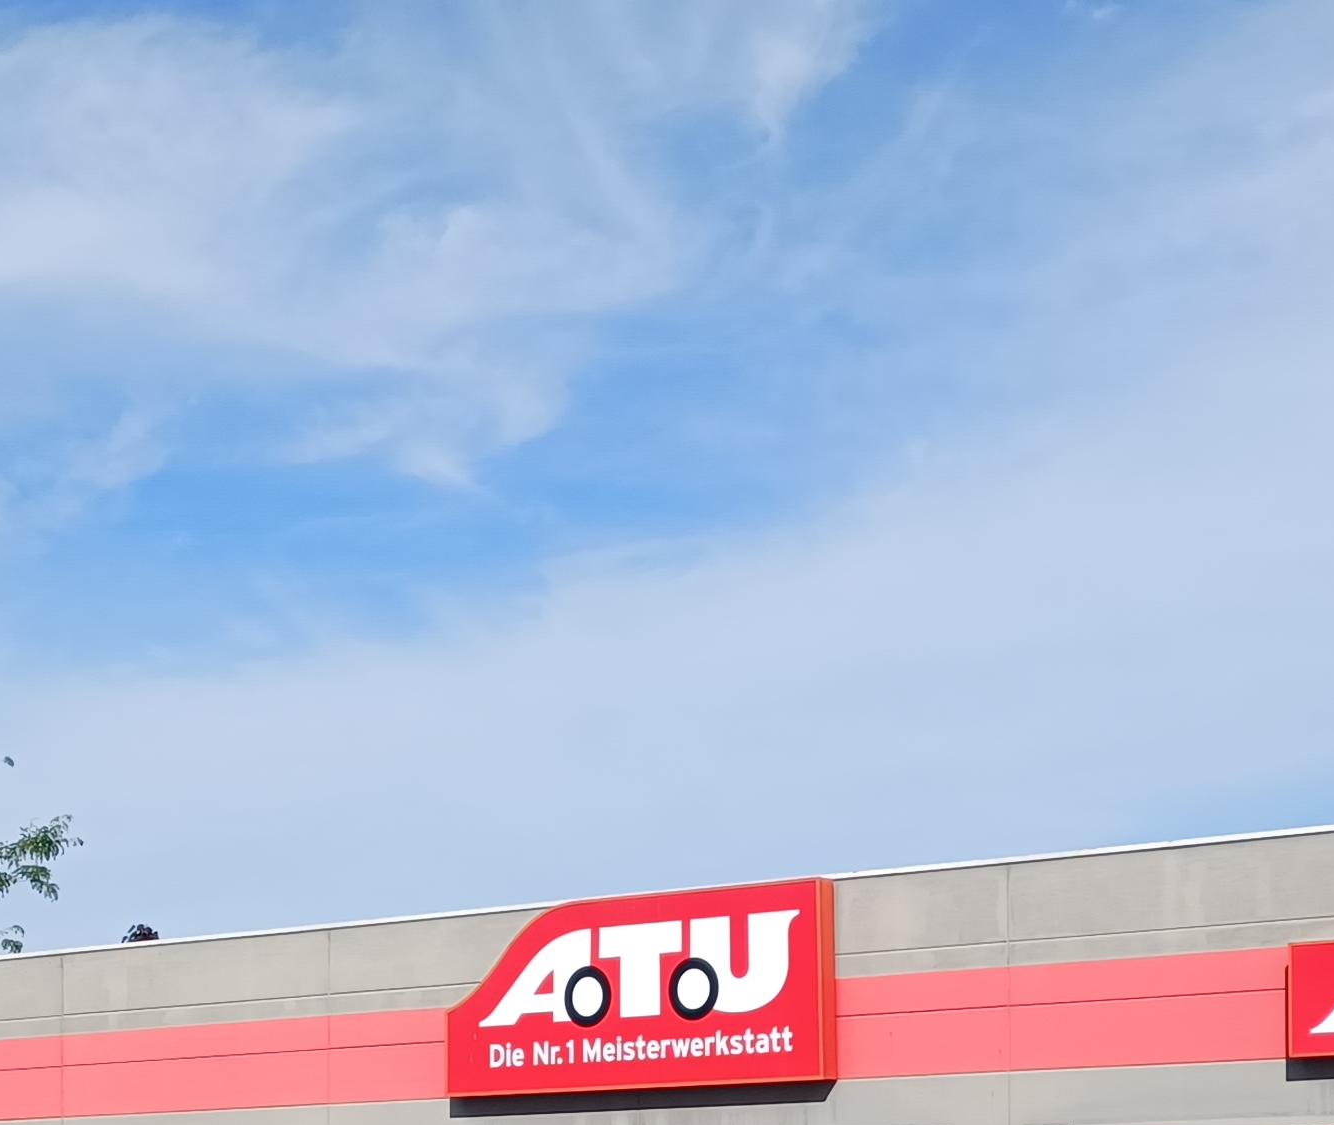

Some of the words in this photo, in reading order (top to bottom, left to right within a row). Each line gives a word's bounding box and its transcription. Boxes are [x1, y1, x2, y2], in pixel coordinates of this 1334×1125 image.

[479, 909, 800, 1029] ATU
[489, 1043, 525, 1068] Die
[582, 1026, 794, 1063] Meisterwerkstatt
